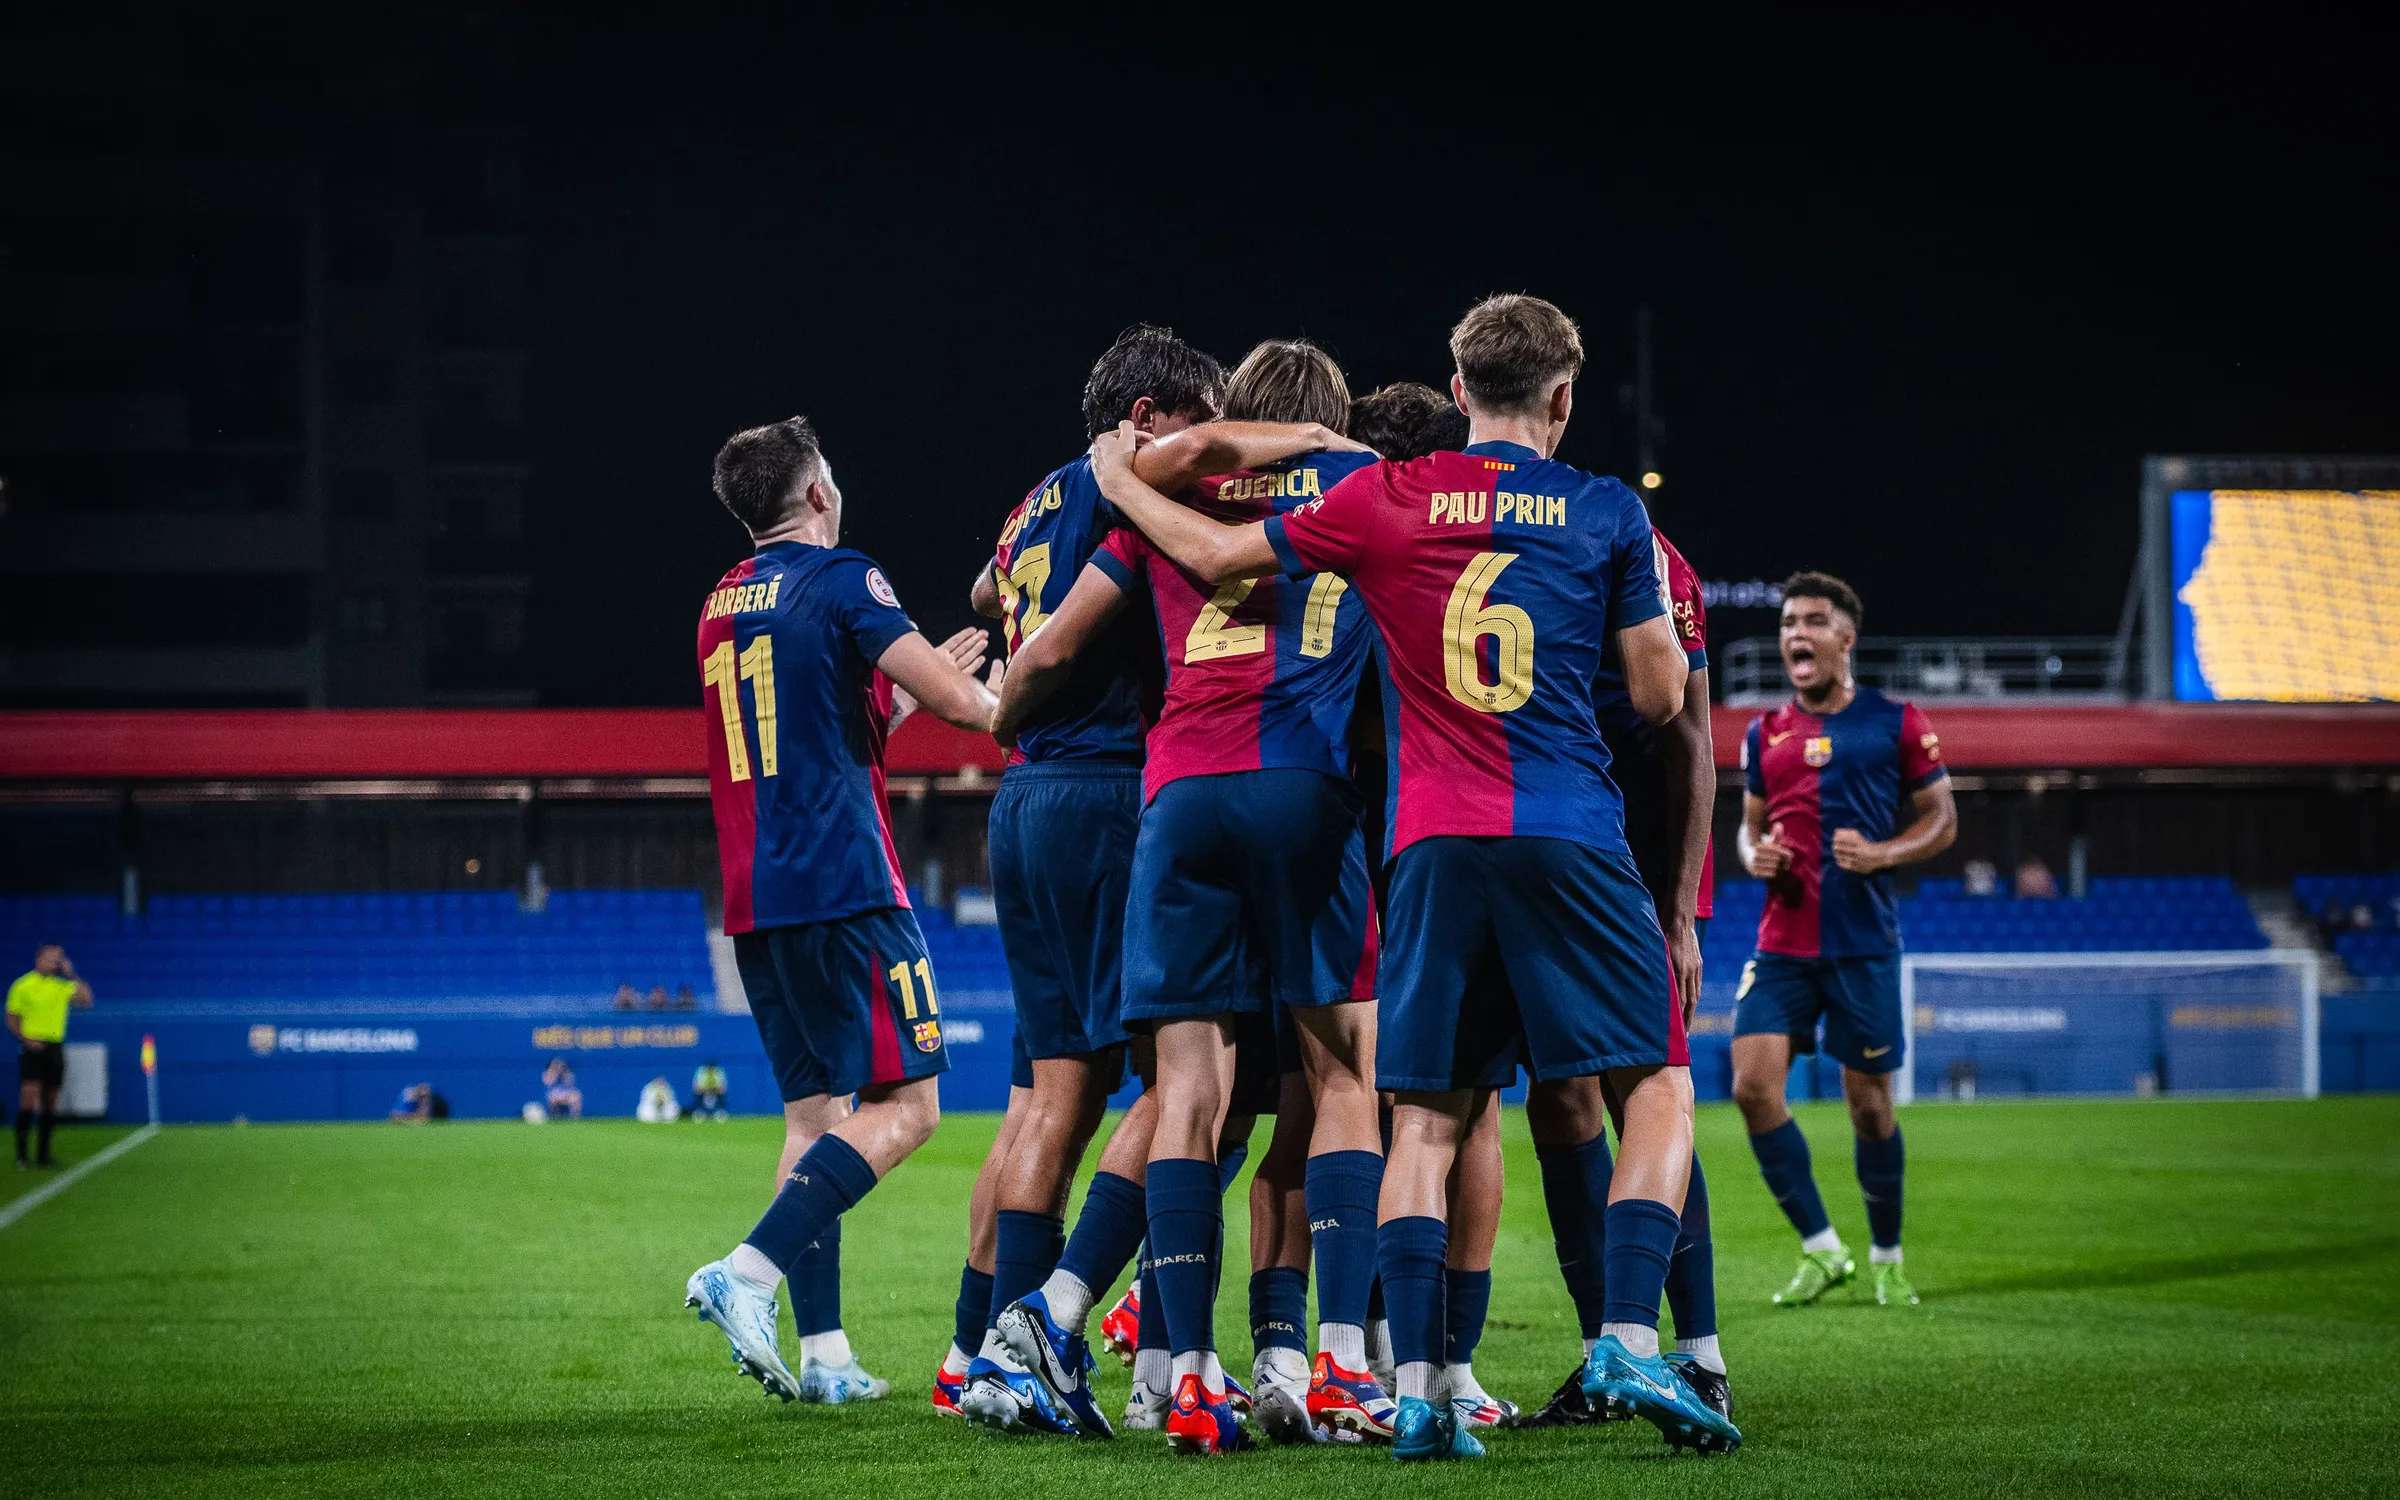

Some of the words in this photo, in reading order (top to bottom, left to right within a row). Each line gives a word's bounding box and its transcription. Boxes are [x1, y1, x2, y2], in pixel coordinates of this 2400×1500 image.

[1217, 468, 1321, 500] CUENCA
[1429, 491, 1487, 524] PAU
[1495, 491, 1566, 526] PRIM
[706, 573, 783, 621] BARBERÁ
[1442, 552, 1535, 712] 6
[703, 634, 778, 783] 11
[889, 957, 939, 1020] 11
[1154, 1253, 1207, 1269] BARÇA
